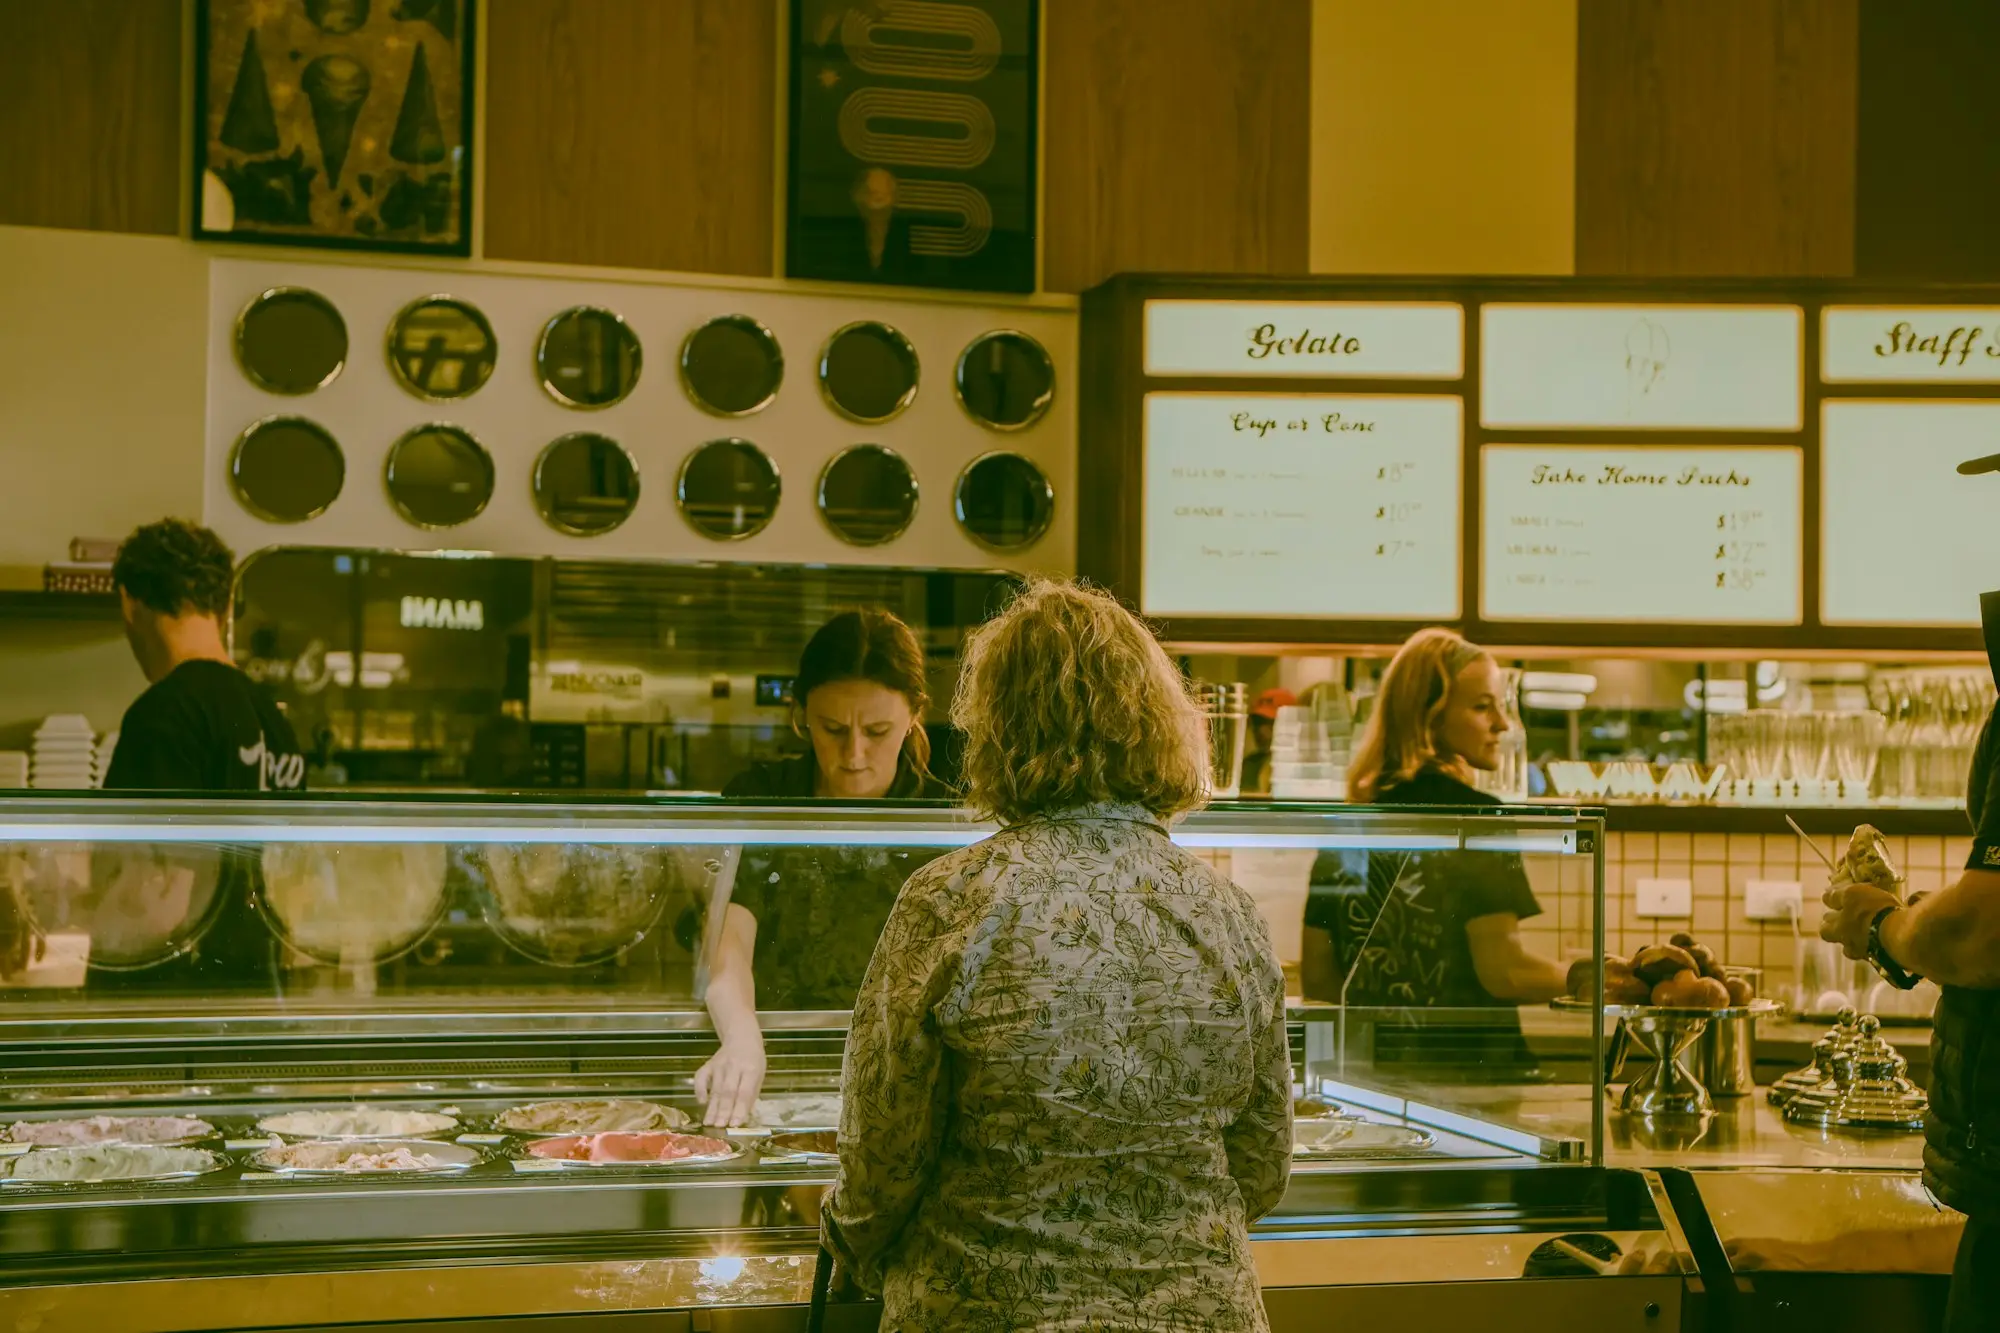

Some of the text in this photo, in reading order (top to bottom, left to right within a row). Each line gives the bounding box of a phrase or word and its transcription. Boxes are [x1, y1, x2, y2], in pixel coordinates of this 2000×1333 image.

[1247, 323, 1361, 358] Gelato
[1873, 321, 1983, 366] Staff
[1231, 412, 1376, 437] Cup or Cone
[1531, 465, 1751, 487] Take Home Packs
